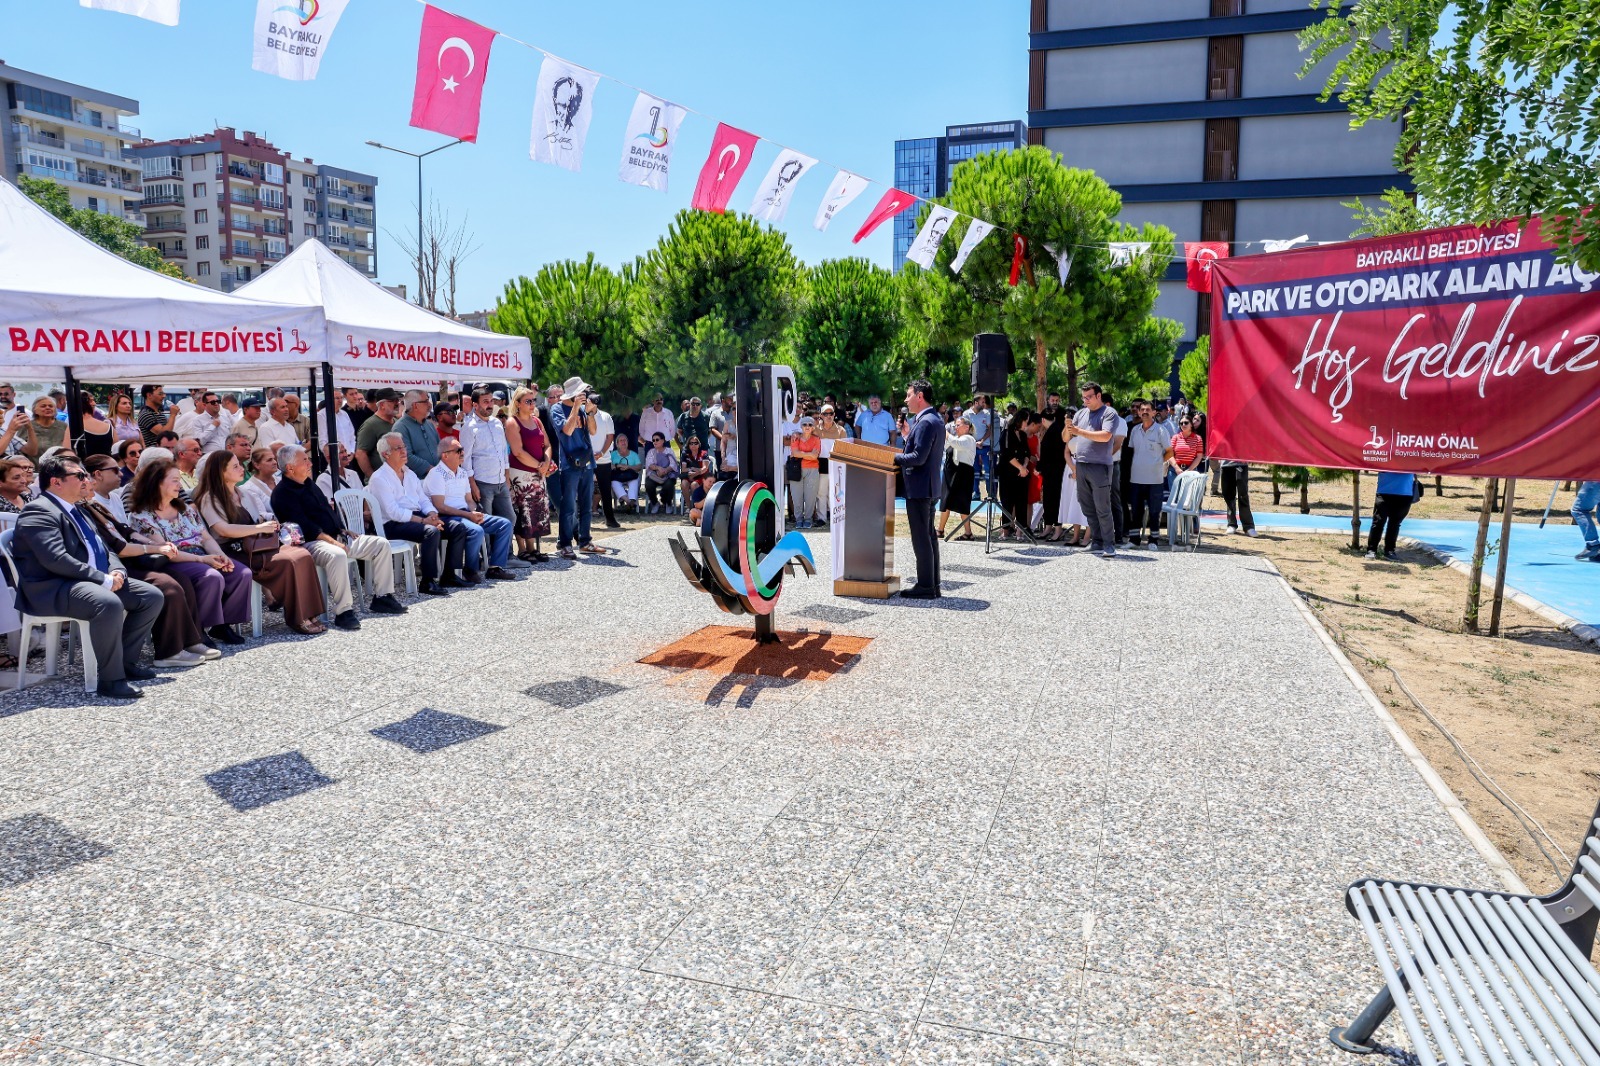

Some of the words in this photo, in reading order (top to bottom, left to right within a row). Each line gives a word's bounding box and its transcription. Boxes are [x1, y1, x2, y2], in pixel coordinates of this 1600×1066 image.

[268, 21, 322, 45] BAYRAKLI
[267, 37, 318, 57] BELEDİYESİ
[1356, 244, 1425, 268] BAYRAKLI
[1428, 228, 1522, 259] BELEDİYESİ
[1227, 287, 1280, 314] PARK
[1283, 284, 1313, 310] VE
[1315, 270, 1441, 307] OTOPARK
[1443, 258, 1541, 297] ALANI
[8, 327, 151, 352] BAYRAKLI
[158, 326, 284, 352] BELEDİYESİ
[367, 340, 437, 363] BAYRAKLI
[440, 347, 509, 369] BELEDİYESİ
[1292, 310, 1370, 423] Hoş
[1383, 294, 1600, 400] Geldiniz
[1396, 432, 1434, 448] İRFAN
[1437, 433, 1479, 450] ÖNAL
[1395, 449, 1420, 457] Bayraklı
[1451, 451, 1480, 460] Başkanı
